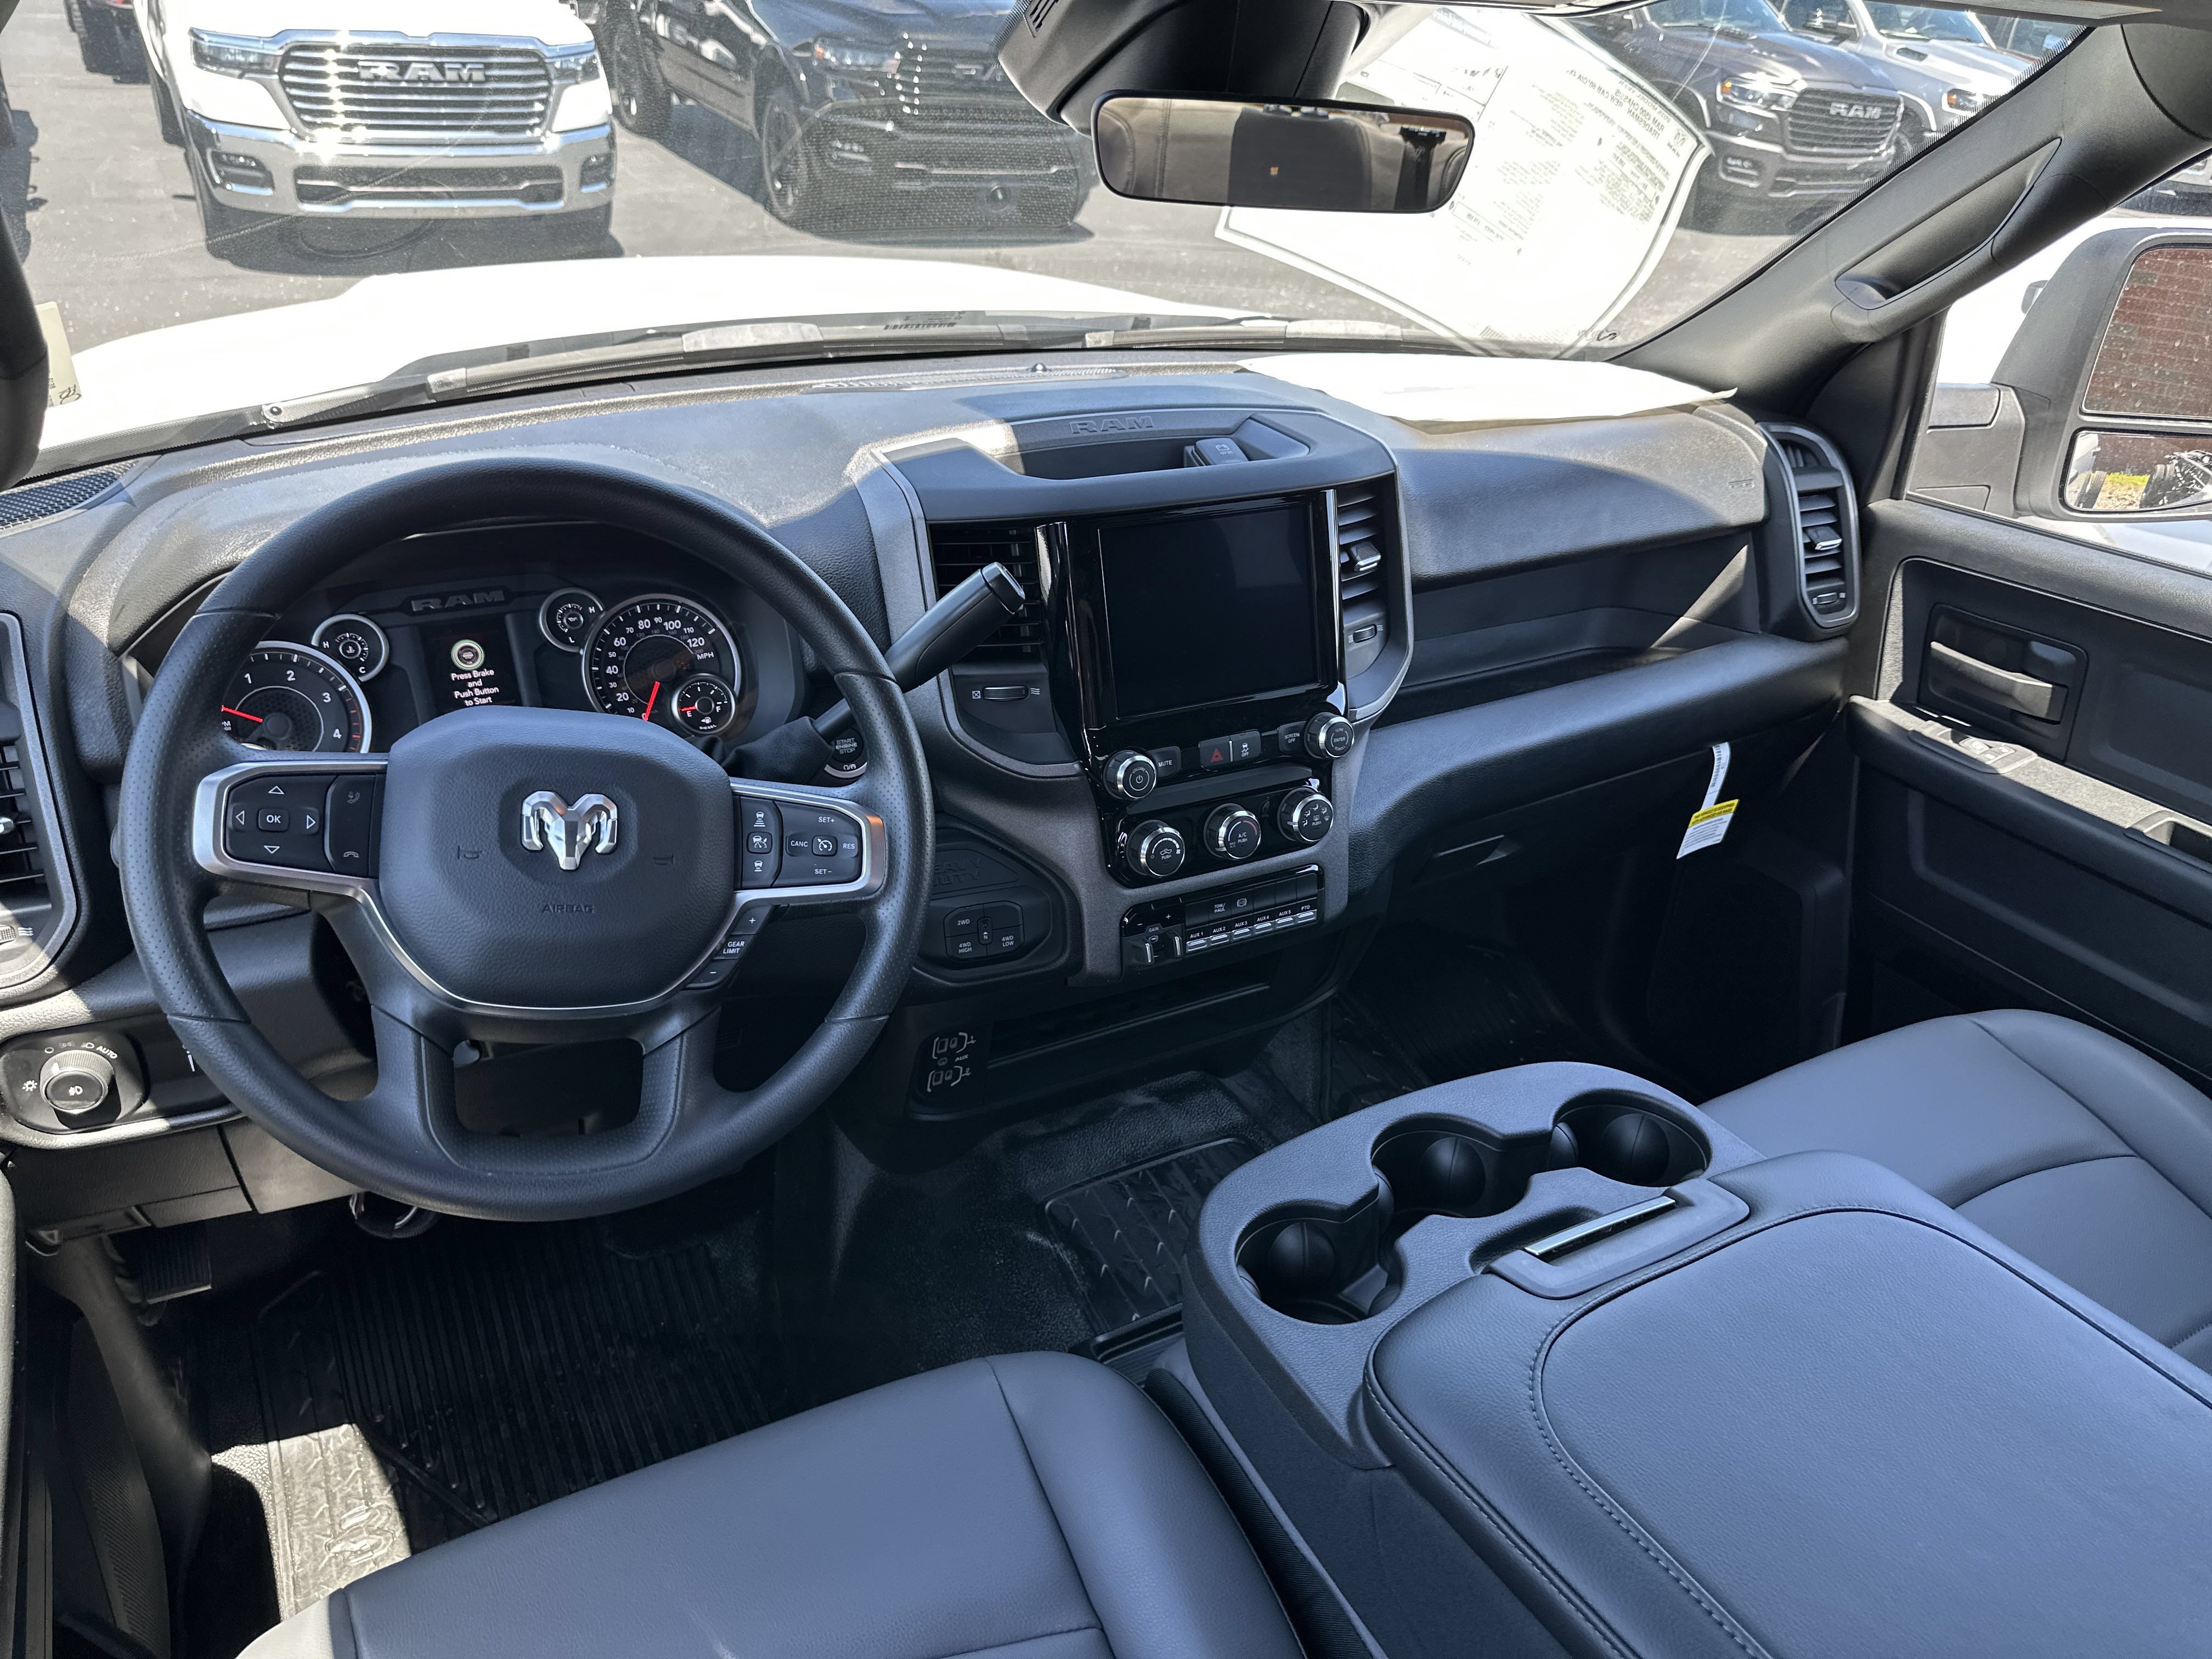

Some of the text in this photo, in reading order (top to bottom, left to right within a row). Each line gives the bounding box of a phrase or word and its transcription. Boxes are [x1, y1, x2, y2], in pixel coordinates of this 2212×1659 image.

[358, 61, 486, 81] RAM
[1829, 101, 1882, 119] RAM
[1070, 416, 1154, 435] RAM
[411, 590, 505, 612] RAM
[638, 619, 651, 630] 80
[663, 619, 681, 631] 100
[613, 637, 627, 647] 60
[687, 637, 705, 648] 120
[697, 651, 714, 661] MPH
[286, 670, 296, 681] 2
[451, 668, 494, 681] Press Brake
[606, 665, 619, 675] 40
[244, 673, 252, 684] 1
[467, 679, 483, 688] and
[322, 692, 331, 703] 3
[454, 687, 499, 699] Push Button
[616, 692, 629, 702] 20
[473, 697, 493, 705] Start
[333, 729, 342, 739] 4
[266, 814, 281, 824] OK
[934, 857, 981, 873] EAVY
[542, 904, 595, 914] AIRBAG
[96, 1045, 117, 1059] AUTO
[955, 1054, 969, 1062] AUX
